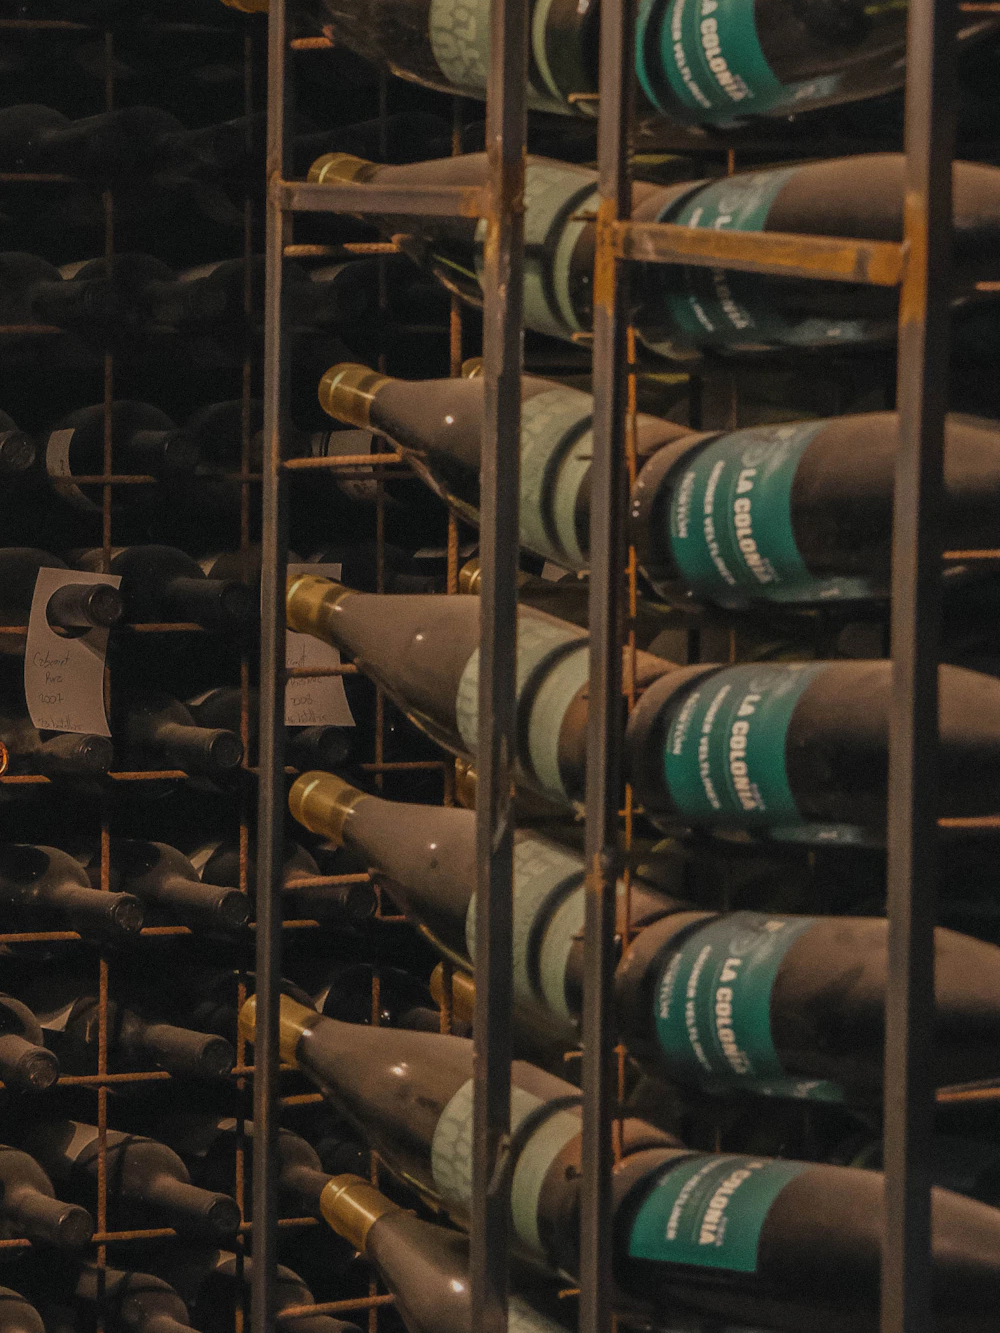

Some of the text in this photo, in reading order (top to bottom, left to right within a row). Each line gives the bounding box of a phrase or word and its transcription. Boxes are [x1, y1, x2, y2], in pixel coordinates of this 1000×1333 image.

[700, 17, 746, 102] COLONIA
[736, 468, 757, 494] LA
[734, 497, 773, 584] COLONIA
[729, 693, 761, 811] LA COLONIA
[715, 957, 750, 1074] LA COLONIA
